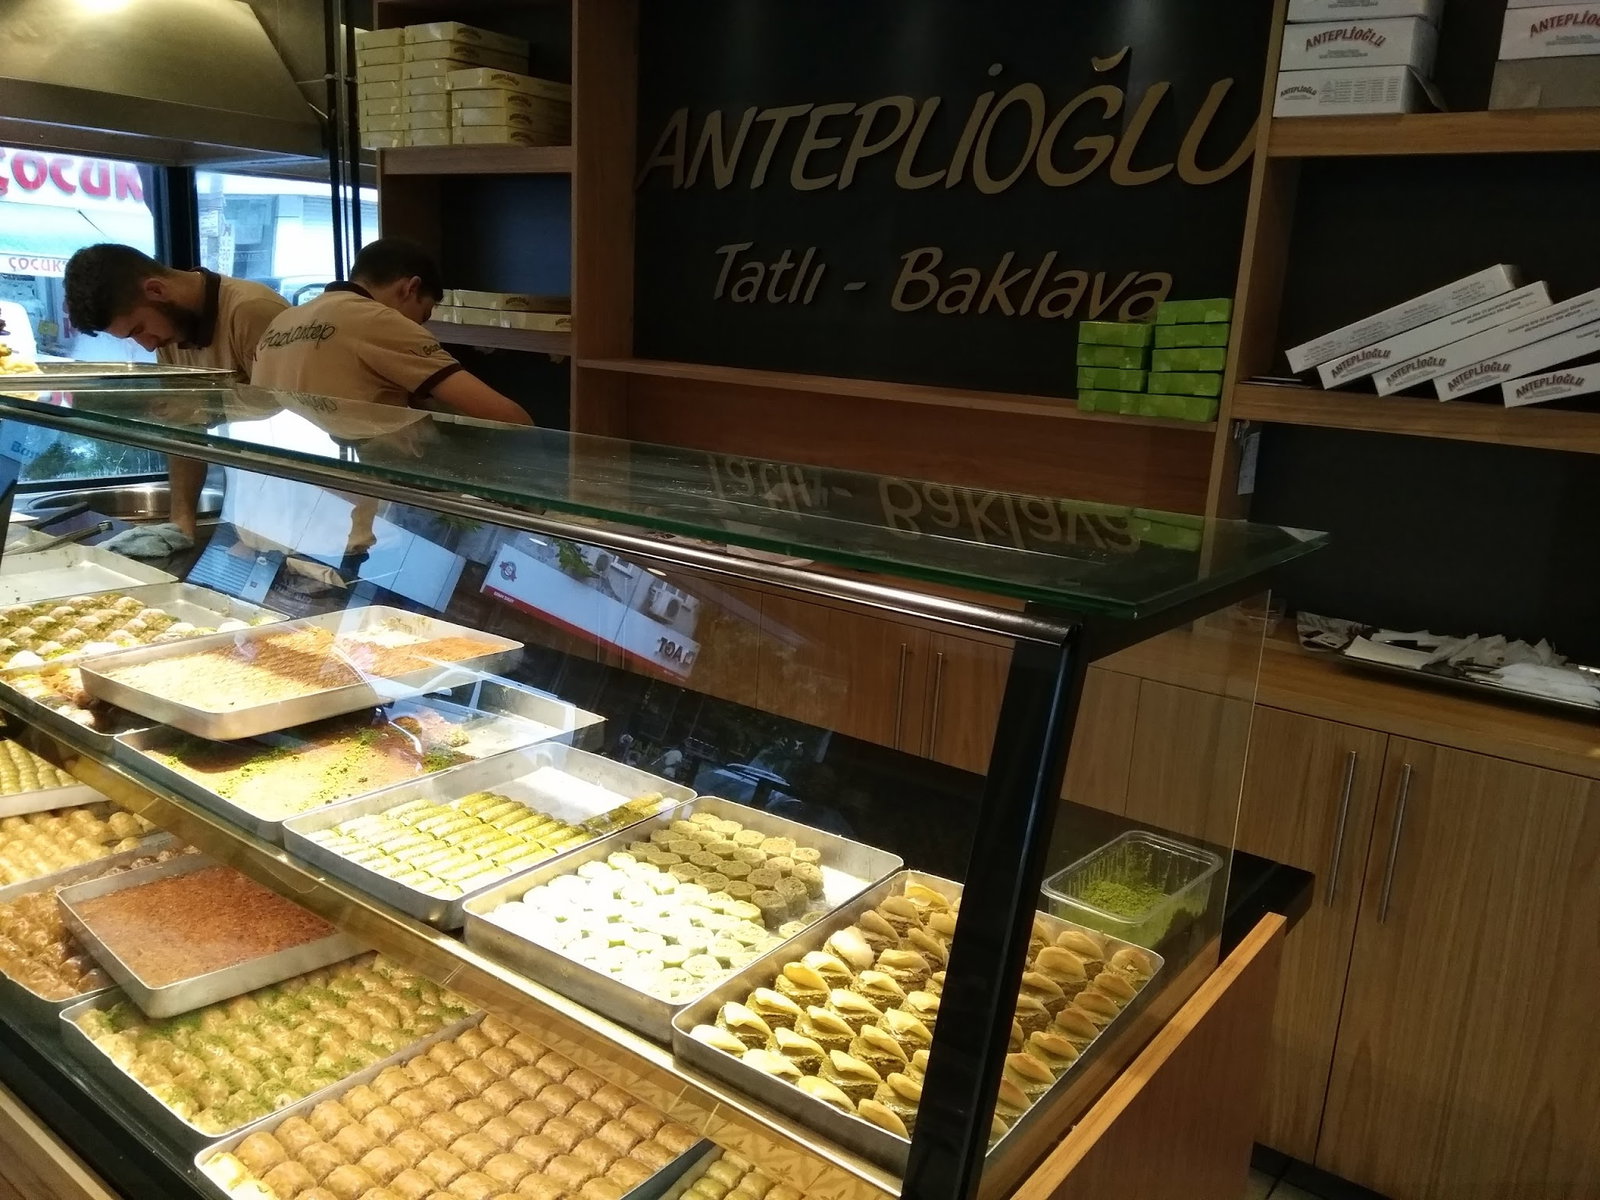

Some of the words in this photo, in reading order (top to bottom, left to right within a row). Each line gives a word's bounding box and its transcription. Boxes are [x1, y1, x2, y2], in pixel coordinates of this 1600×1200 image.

[1305, 26, 1387, 52] ANTEPLİOĞLU
[636, 46, 1257, 194] ANTEPLİOĞLU
[0, 146, 145, 202] OCUK
[8, 256, 66, 273] ÇOCUK
[713, 241, 826, 304] Tatlı
[890, 246, 1173, 321] Baklava
[1331, 348, 1391, 379] ANTEPLİOĞLU
[1385, 356, 1447, 387] ANTEPLİOĞLU
[1447, 361, 1511, 393] ANTEPLİOĞLU
[1515, 373, 1585, 399] ANTEPLİOĞLU
